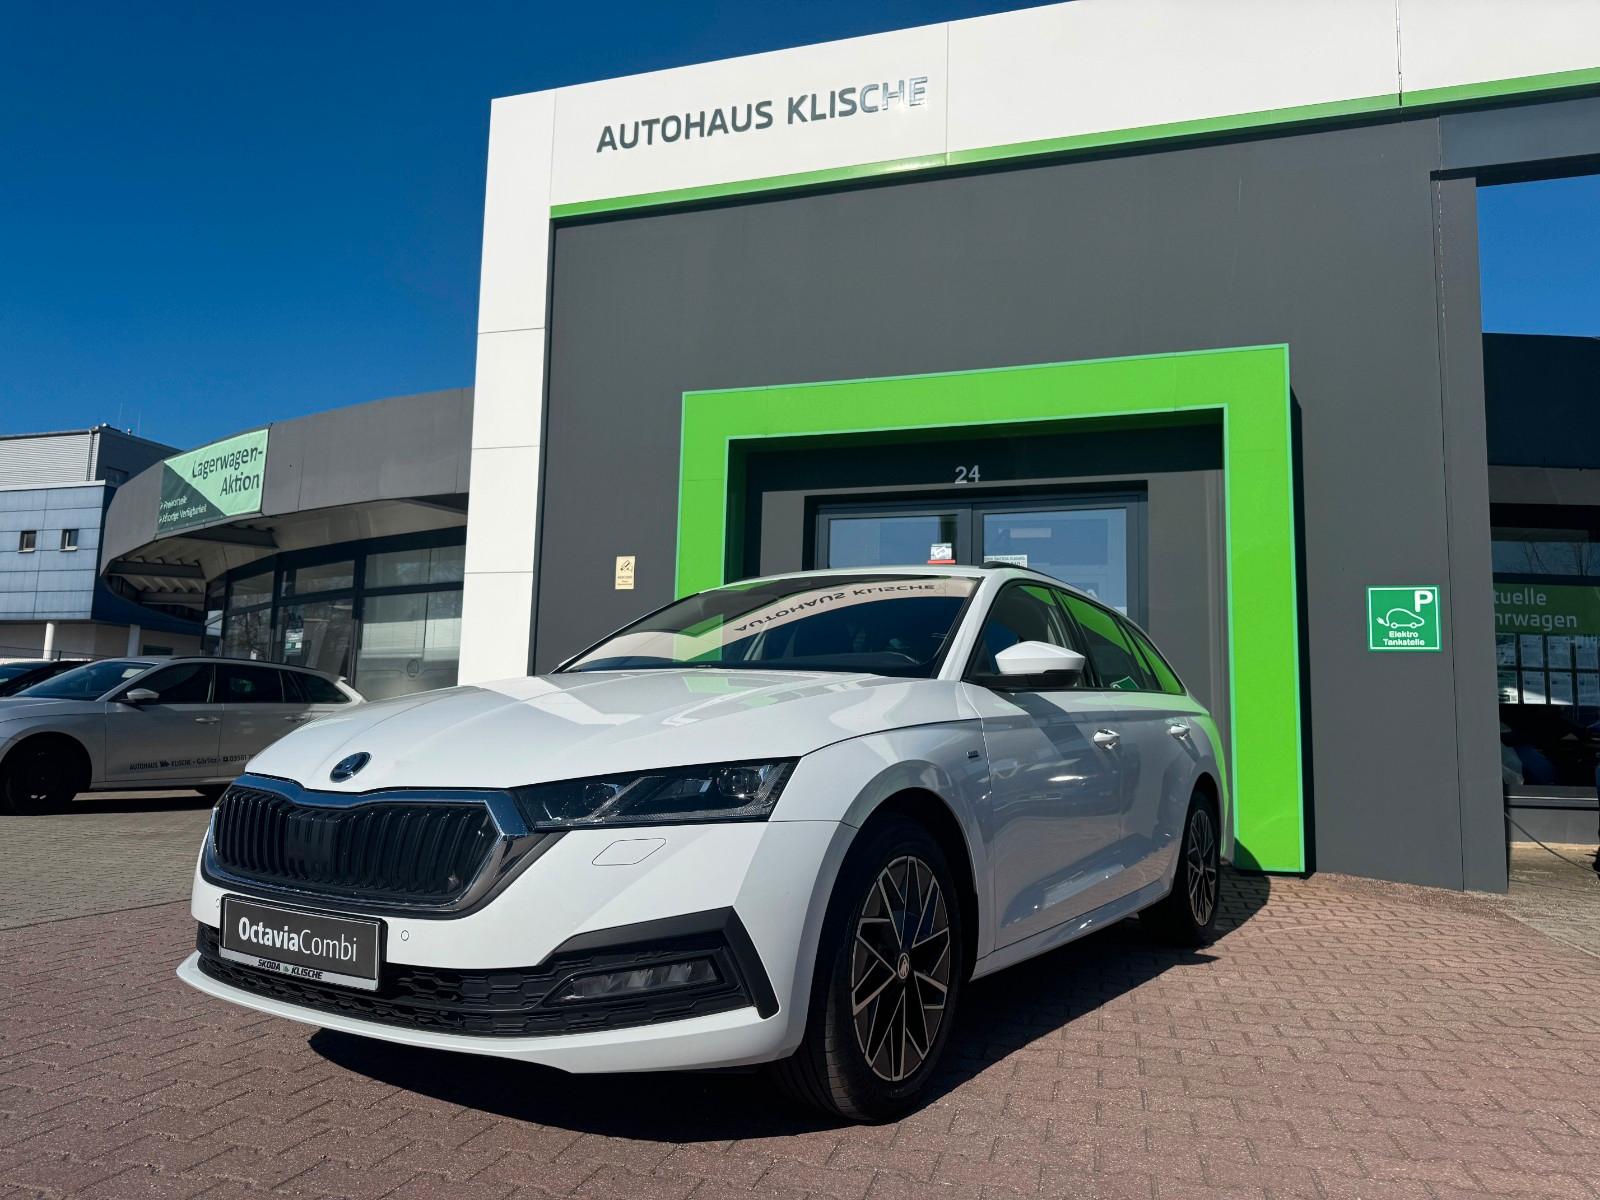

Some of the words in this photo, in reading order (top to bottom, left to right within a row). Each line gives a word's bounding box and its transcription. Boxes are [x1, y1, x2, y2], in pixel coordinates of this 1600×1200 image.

[596, 101, 774, 153] AUTOHAUS
[787, 76, 928, 125] KLISCHE
[192, 446, 263, 479] Lagerwagen-
[220, 471, 260, 497] Aktion
[955, 465, 981, 484] 24
[1414, 590, 1434, 612] P
[1382, 638, 1425, 646] Tankstelle
[1388, 630, 1419, 638] Elektro
[129, 762, 159, 770] AUTOHAUS
[291, 965, 323, 979] KLISCHE
